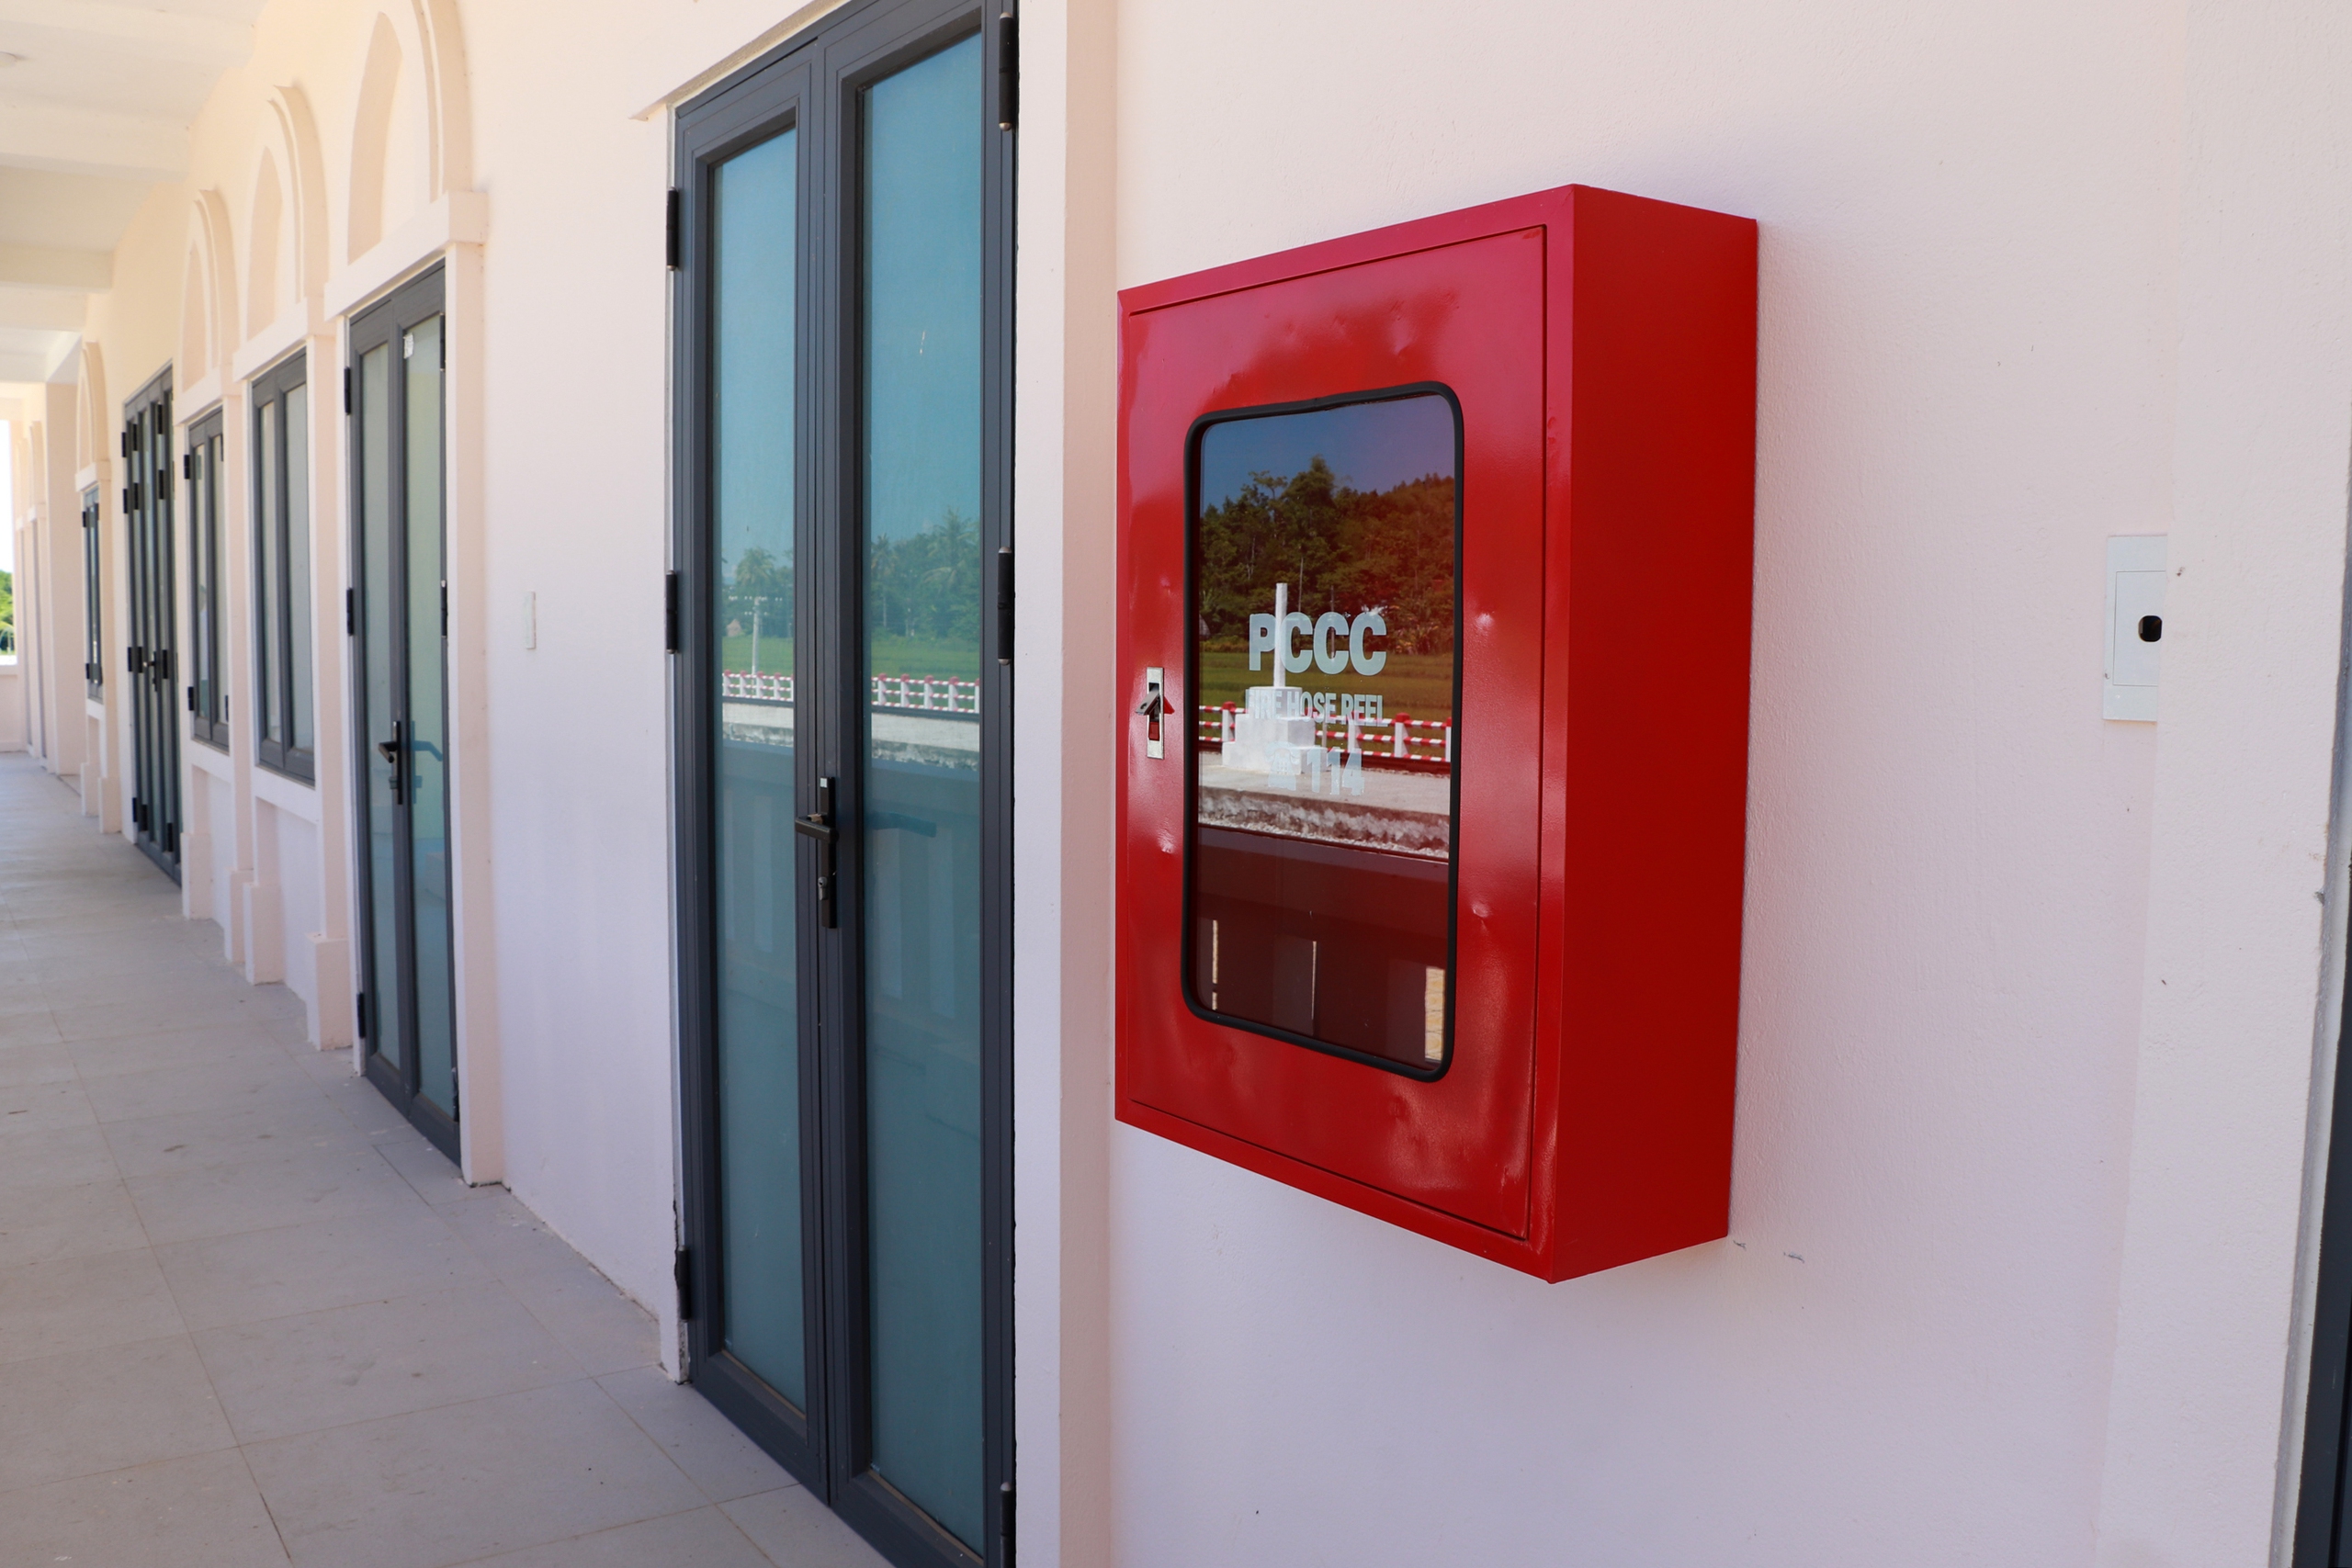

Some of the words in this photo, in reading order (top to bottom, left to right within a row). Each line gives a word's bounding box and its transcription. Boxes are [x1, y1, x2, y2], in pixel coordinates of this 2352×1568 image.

[1249, 612, 1387, 676] PCCC
[1286, 691, 1339, 724] HOSE
[1341, 694, 1389, 728] REEL
[1306, 747, 1365, 796] 114
